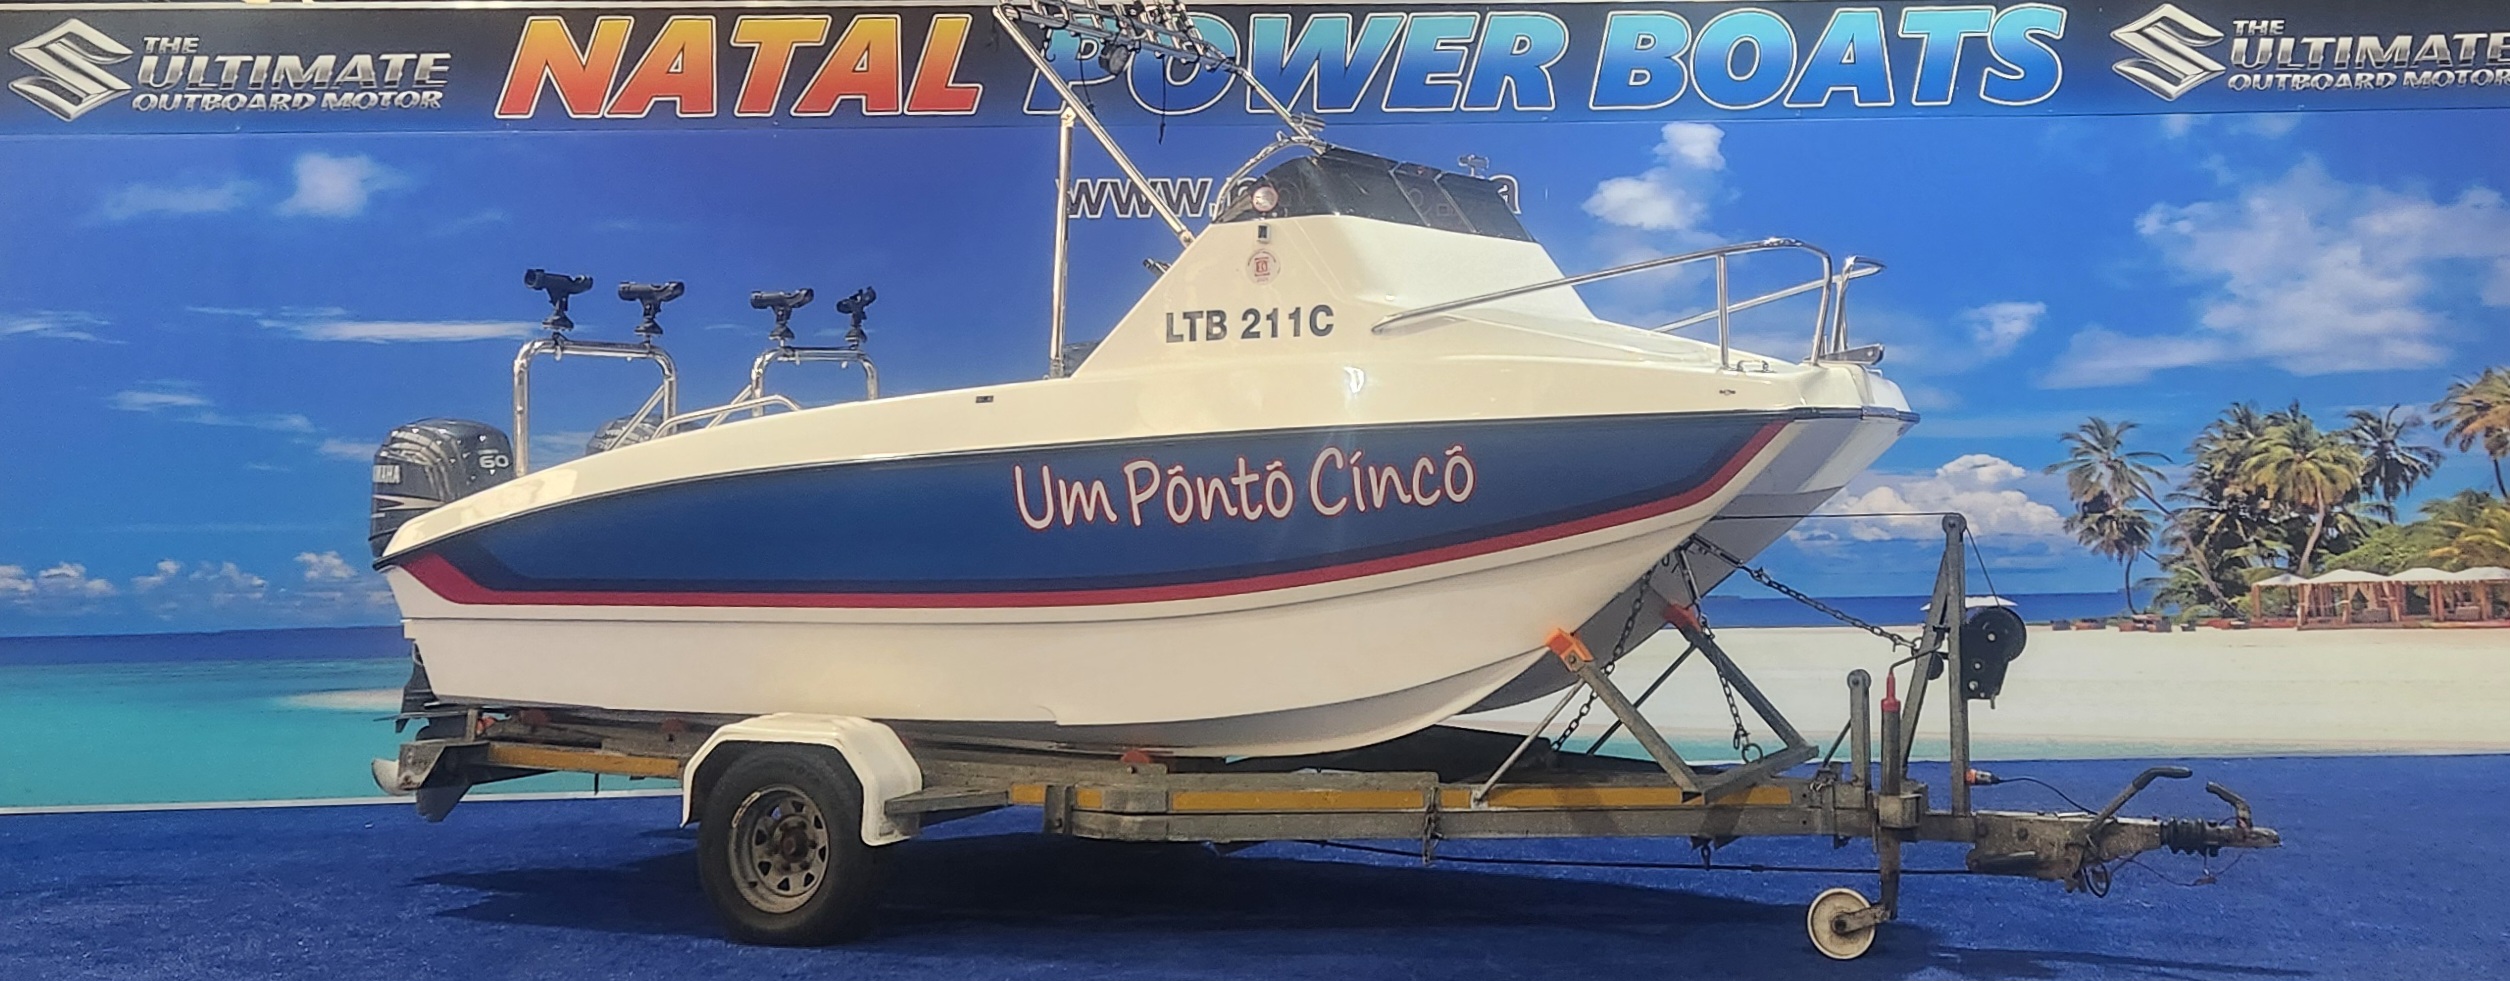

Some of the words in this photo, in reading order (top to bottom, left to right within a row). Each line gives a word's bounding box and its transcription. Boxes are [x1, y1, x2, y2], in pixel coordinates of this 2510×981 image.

[2231, 19, 2286, 36] THE
[142, 36, 200, 54] THE
[2229, 31, 2510, 71] ULTIMATE
[136, 52, 452, 89] ULTIMATE
[494, 14, 984, 119] NATAL
[1022, 11, 1569, 116] POWER
[1589, 3, 2068, 111] BOATS
[2227, 71, 2398, 91] OUTBOARD
[2402, 68, 2510, 89] MOTOR
[131, 91, 315, 112] OUTBOARD
[323, 90, 443, 111] MOTOR
[1166, 310, 1229, 344] LTB
[1240, 304, 1335, 340] 211C
[478, 454, 510, 469] 60
[1013, 464, 1118, 530] Um
